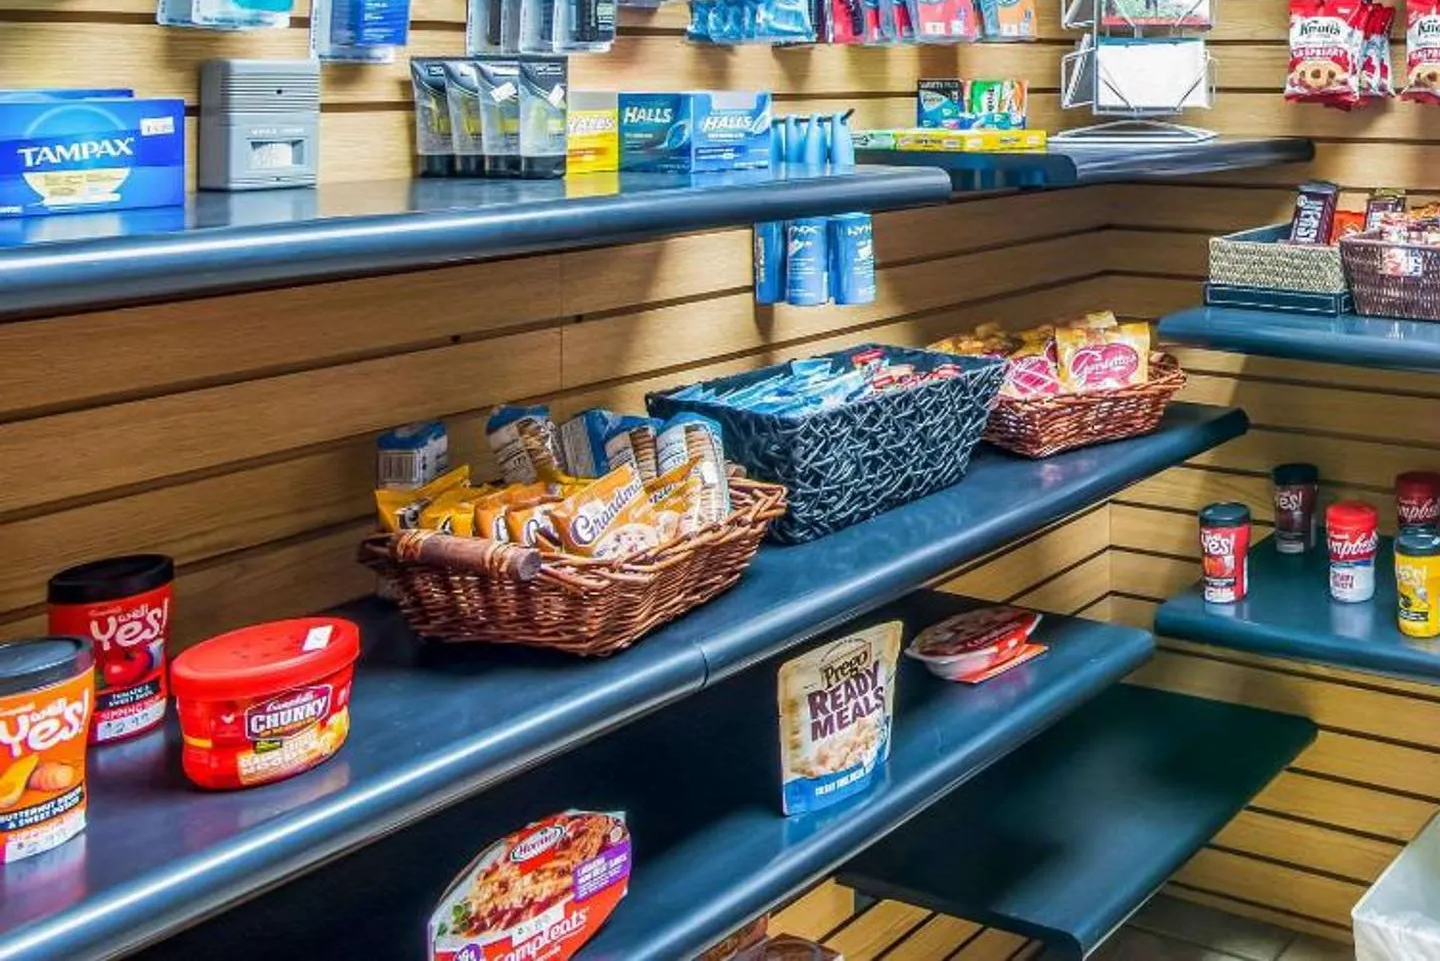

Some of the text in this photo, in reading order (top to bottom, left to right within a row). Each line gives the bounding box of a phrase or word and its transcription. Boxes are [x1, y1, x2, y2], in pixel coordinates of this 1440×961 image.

[623, 106, 673, 125] HALLS
[704, 115, 753, 132] HALLS
[17, 137, 131, 168] TAMPAX
[1395, 566, 1428, 586] es!
[90, 597, 169, 651] Yes!
[823, 650, 868, 688] Prego
[807, 660, 880, 720] READY
[0, 688, 90, 758] Yes!
[250, 695, 328, 734] CHUNKY
[811, 686, 885, 742] MEALS
[518, 830, 559, 857] Hormel
